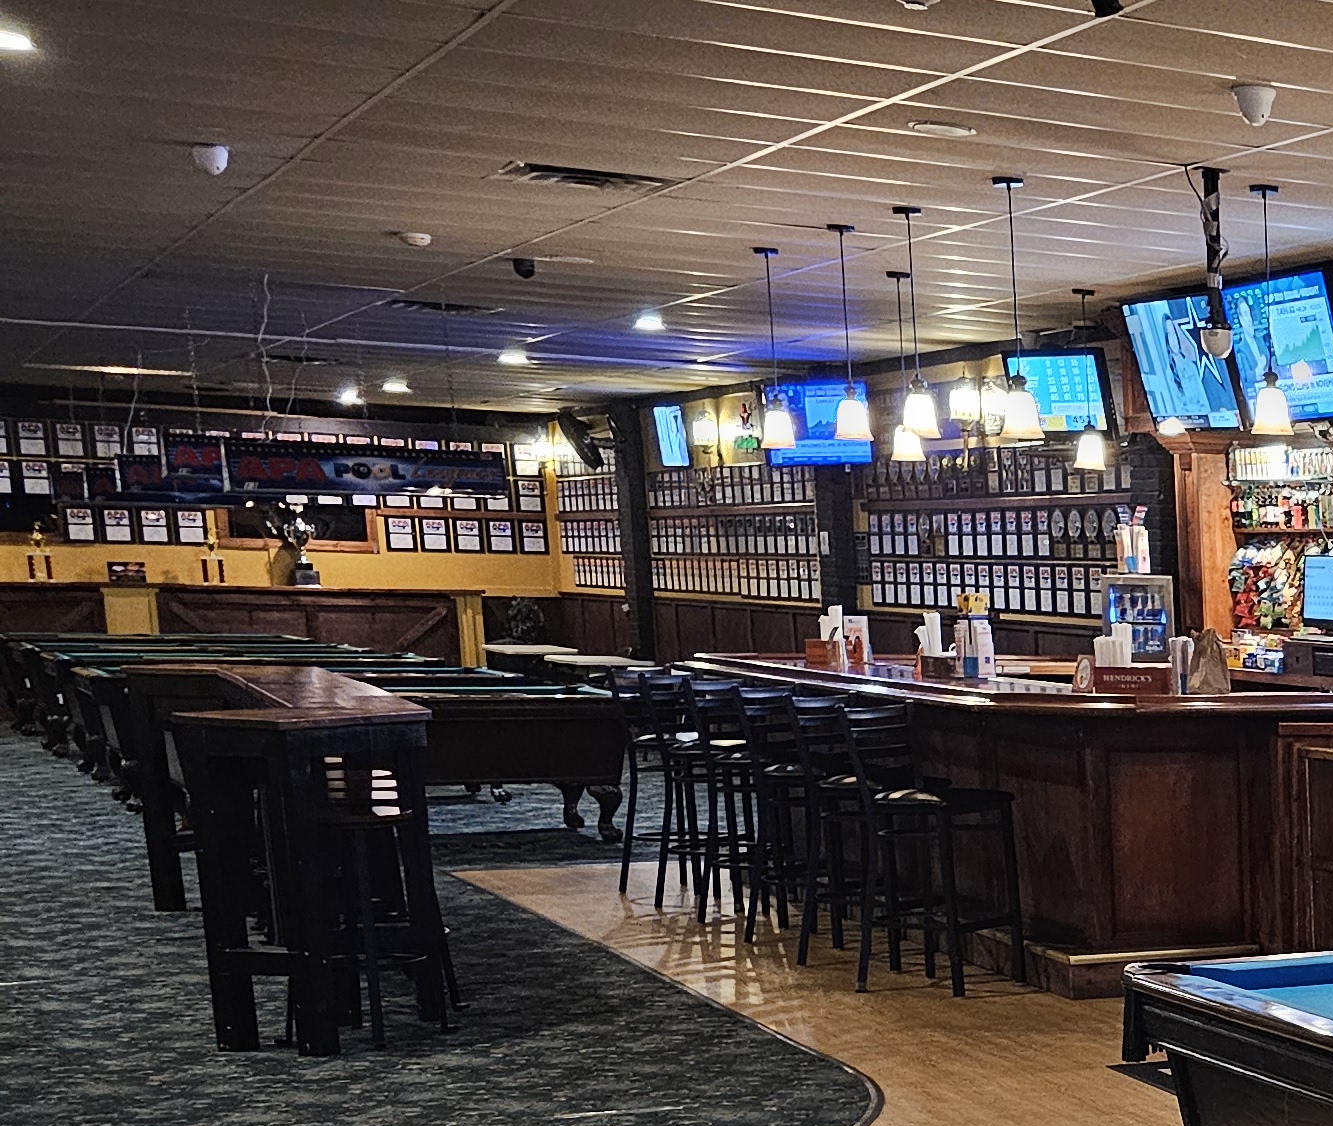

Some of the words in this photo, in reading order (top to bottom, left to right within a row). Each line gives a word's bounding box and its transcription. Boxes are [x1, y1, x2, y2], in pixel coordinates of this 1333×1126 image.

[238, 456, 327, 482] APA
[333, 462, 407, 480] POOL
[1103, 674, 1152, 682] HENDRICK'S
